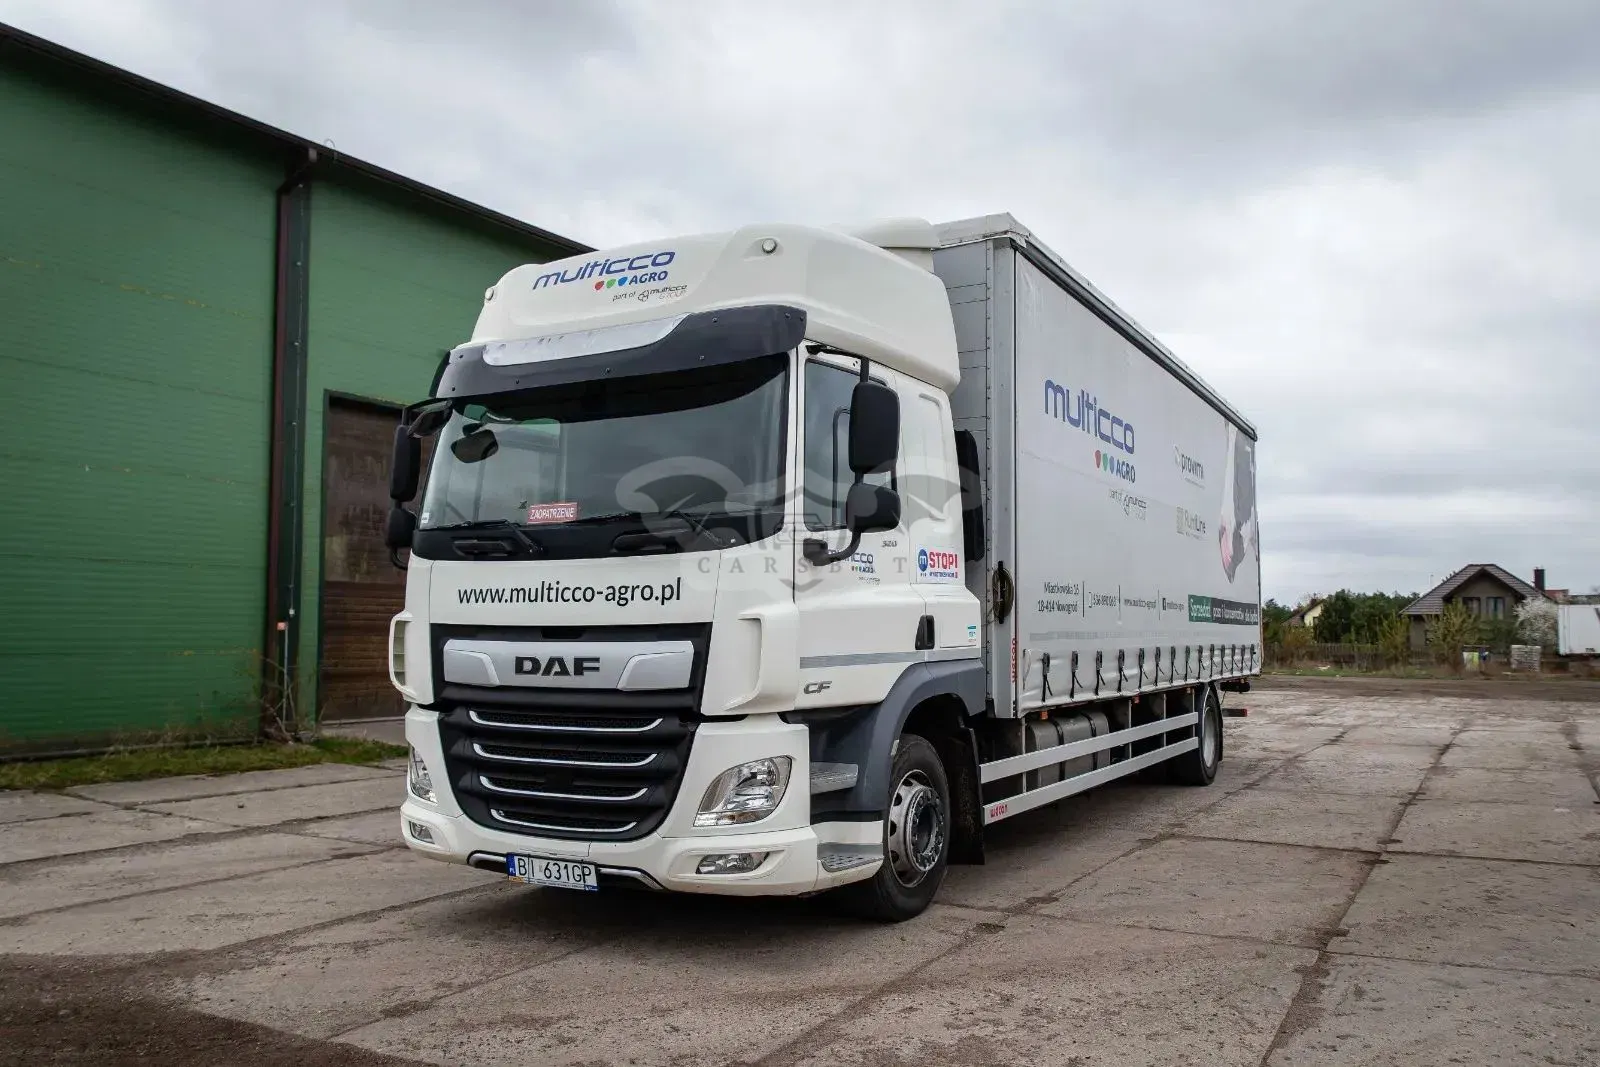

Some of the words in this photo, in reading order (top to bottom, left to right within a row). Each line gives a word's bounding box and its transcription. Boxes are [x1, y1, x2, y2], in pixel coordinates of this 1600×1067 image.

[532, 251, 676, 290] multicco
[629, 270, 668, 285] AGRO
[1044, 379, 1135, 454] multicco
[1116, 459, 1136, 483] AGRO
[457, 577, 682, 607] www.multicco-agro.pl
[515, 656, 601, 678] DAF
[803, 681, 832, 695] CF
[517, 857, 535, 878] BI
[543, 861, 592, 884] 631GP
